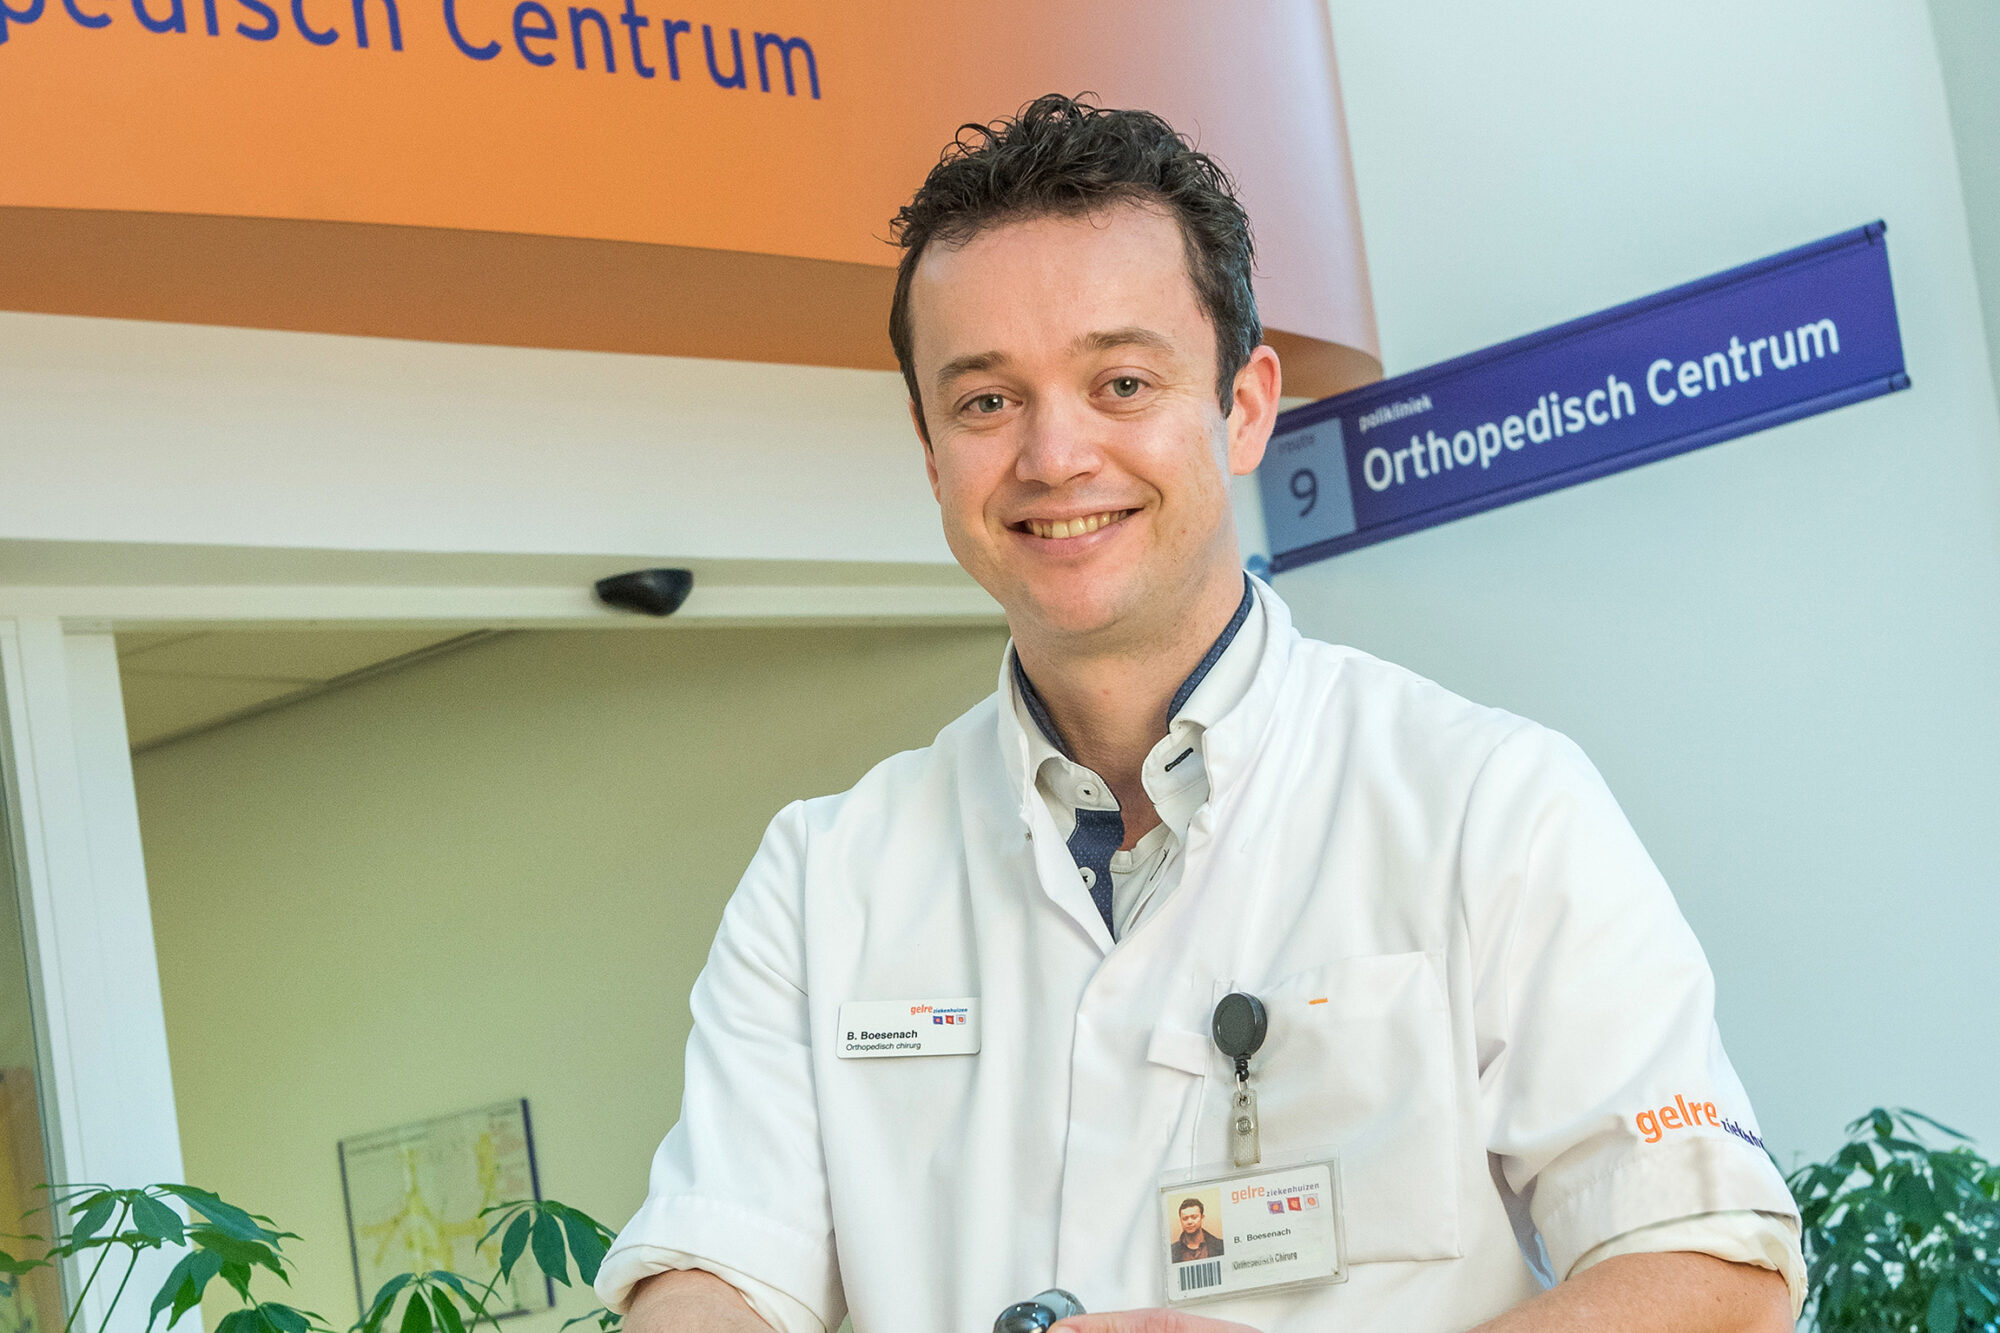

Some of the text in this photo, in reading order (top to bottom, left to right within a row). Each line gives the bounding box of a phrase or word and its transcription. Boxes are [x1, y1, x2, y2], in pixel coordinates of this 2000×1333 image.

[443, 0, 821, 100] Centrum
[1363, 317, 1841, 492] Orthopedisch Centrum
[1289, 467, 1318, 518] 9
[910, 1004, 933, 1015] gelre
[847, 1030, 918, 1040] B. Boesenach
[846, 1042, 921, 1052] Orthopedisch chirurg
[1635, 1093, 1721, 1143] gelre
[1231, 1182, 1320, 1204] gelre ziekenhuizen
[1247, 1228, 1291, 1242] Boesenach
